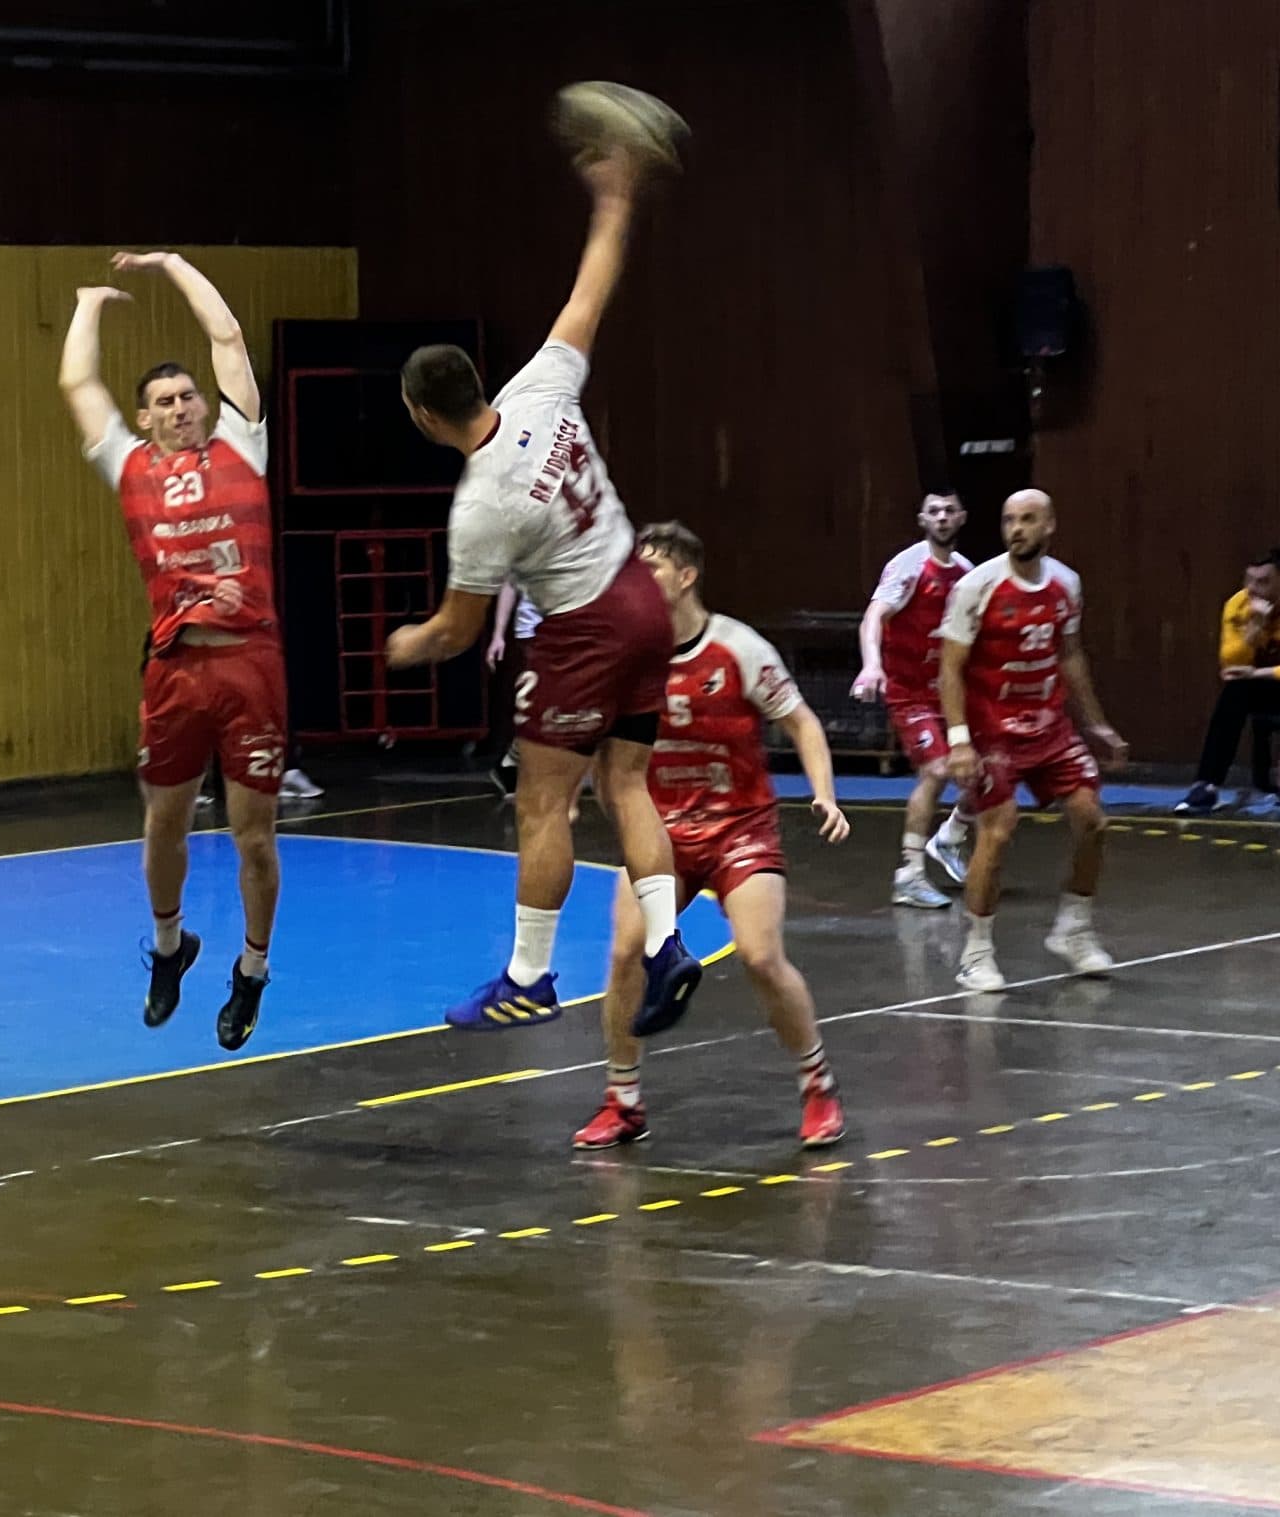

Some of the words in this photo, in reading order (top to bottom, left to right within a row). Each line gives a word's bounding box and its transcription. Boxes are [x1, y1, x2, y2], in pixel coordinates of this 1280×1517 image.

[163, 470, 205, 507] 23
[529, 478, 556, 504] RK
[667, 694, 693, 727] 5
